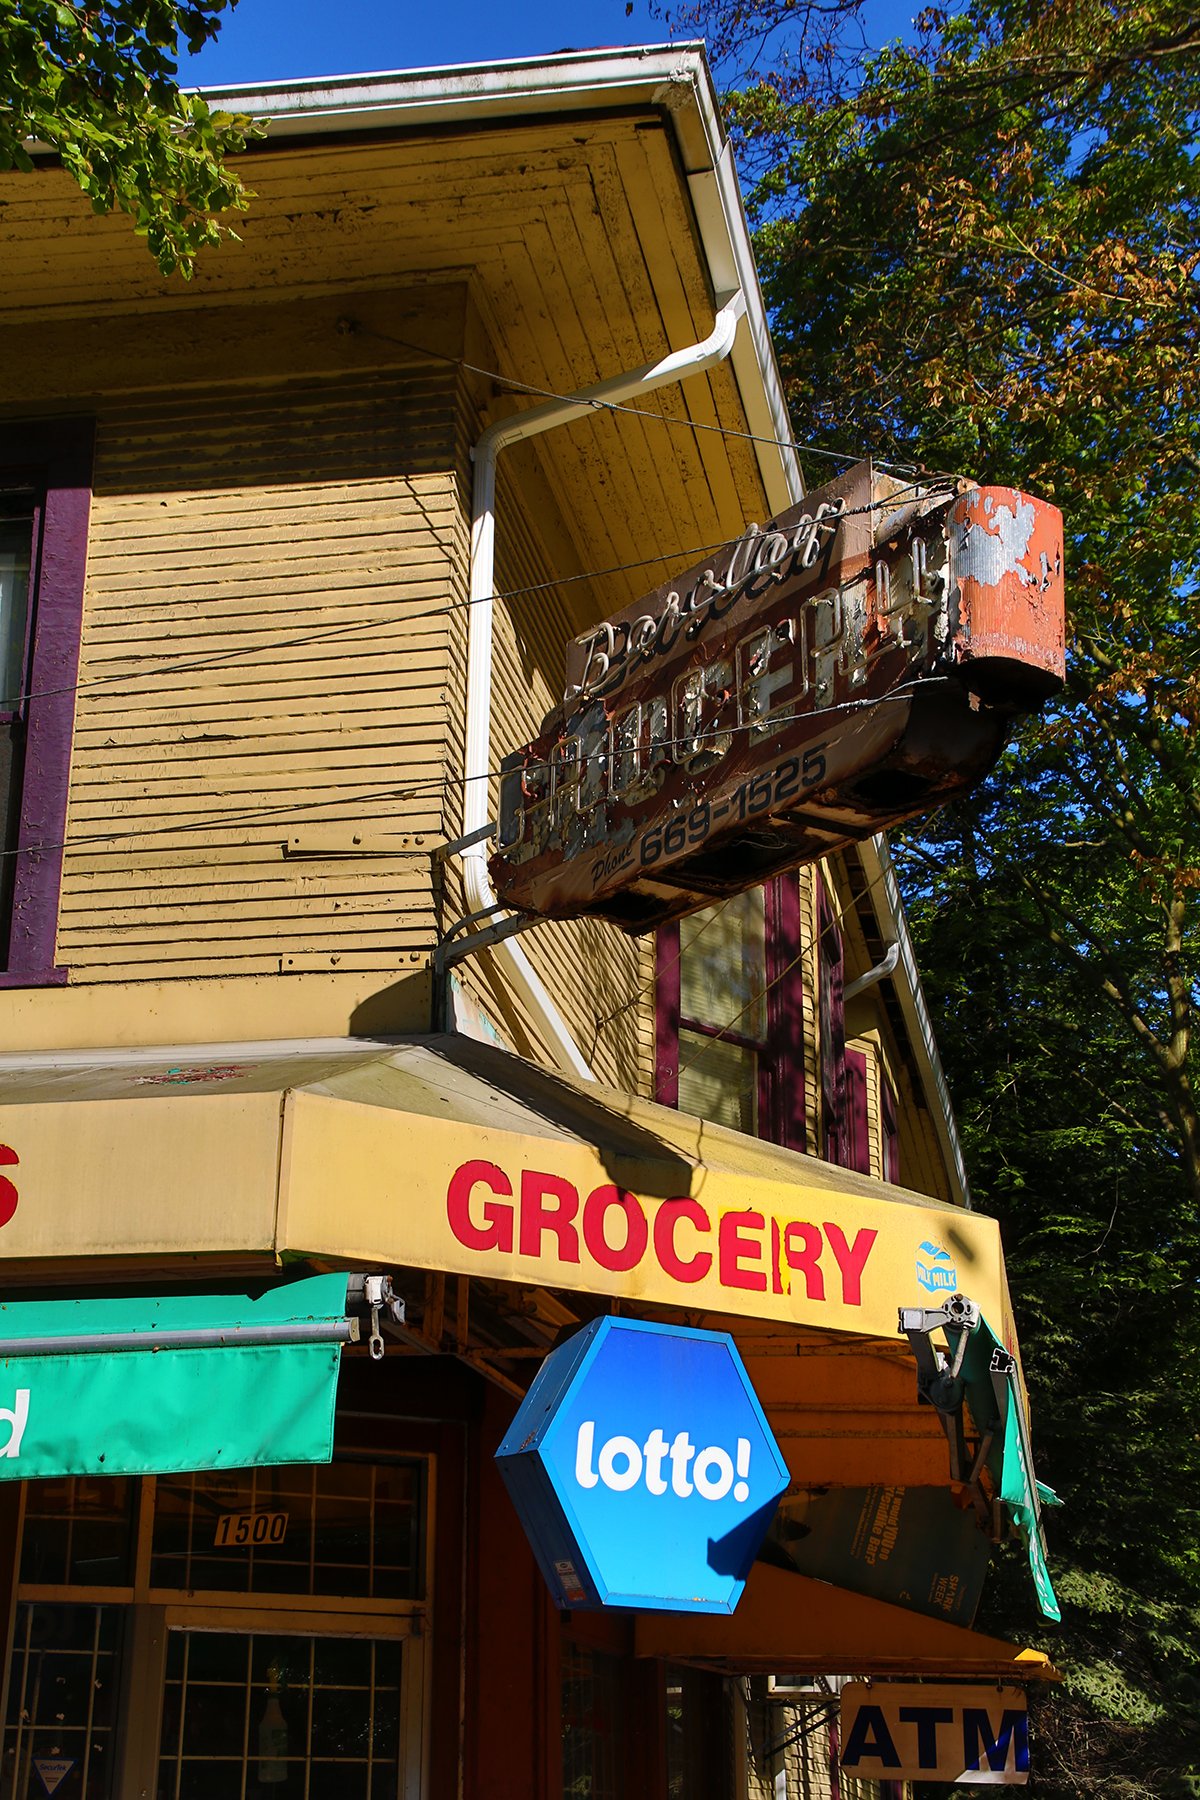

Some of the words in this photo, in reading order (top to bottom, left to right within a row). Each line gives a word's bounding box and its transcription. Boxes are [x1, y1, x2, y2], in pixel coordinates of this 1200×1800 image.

[565, 497, 840, 700] Barclay
[639, 741, 831, 867] 669-1525
[446, 1158, 879, 1307] GROCERY
[932, 1271, 956, 1287] MILK
[575, 1420, 752, 1503] lotto!
[221, 1514, 287, 1545] 1500
[933, 1576, 949, 1605] WEEK
[943, 1574, 960, 1614] SHARK
[840, 1705, 1030, 1772] ATM
